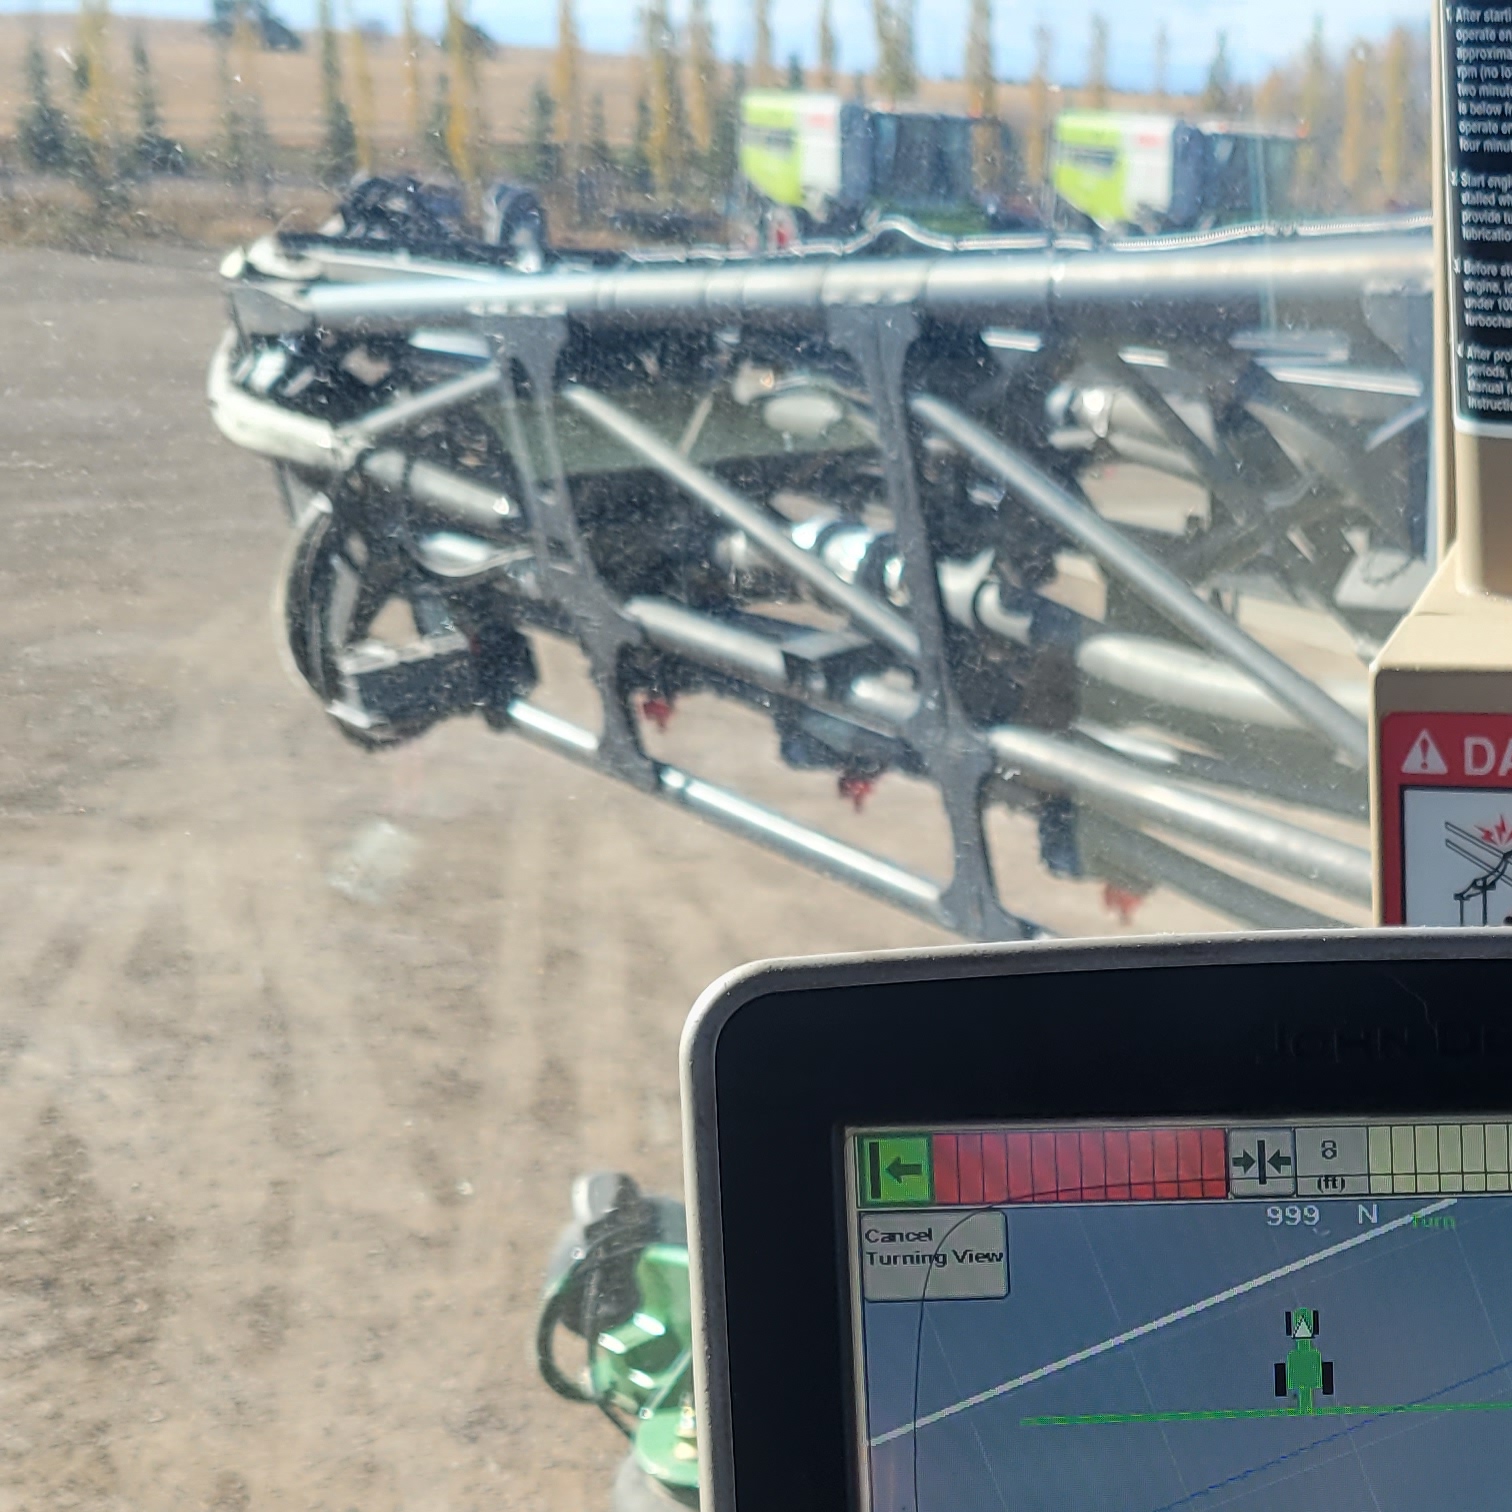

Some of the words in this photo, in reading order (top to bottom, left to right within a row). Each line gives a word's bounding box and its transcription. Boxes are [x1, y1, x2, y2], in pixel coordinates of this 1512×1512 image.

[1456, 9, 1481, 23] After
[1456, 29, 1496, 43] operate
[1457, 67, 1477, 81] rpm
[1481, 66, 1498, 82] (no
[1458, 84, 1476, 97] two
[1470, 103, 1502, 116] below
[1459, 122, 1498, 136] operate
[1460, 140, 1481, 153] four
[1461, 173, 1485, 188] Start
[1461, 192, 1495, 206] stalled
[1462, 211, 1500, 225] provide
[1464, 261, 1498, 277] Before
[1465, 297, 1494, 310] under
[1467, 345, 1490, 360] After
[1467, 363, 1508, 380] periods,
[1468, 382, 1504, 394] Manual
[1321, 1140, 1337, 1160] 8
[1317, 1175, 1346, 1193] (ft)
[1267, 1206, 1319, 1227] 999
[1358, 1205, 1378, 1224] N
[1413, 1214, 1456, 1229] Turn
[864, 1227, 933, 1243] Cancel
[866, 1250, 948, 1267] Turning
[955, 1248, 1004, 1265] View
